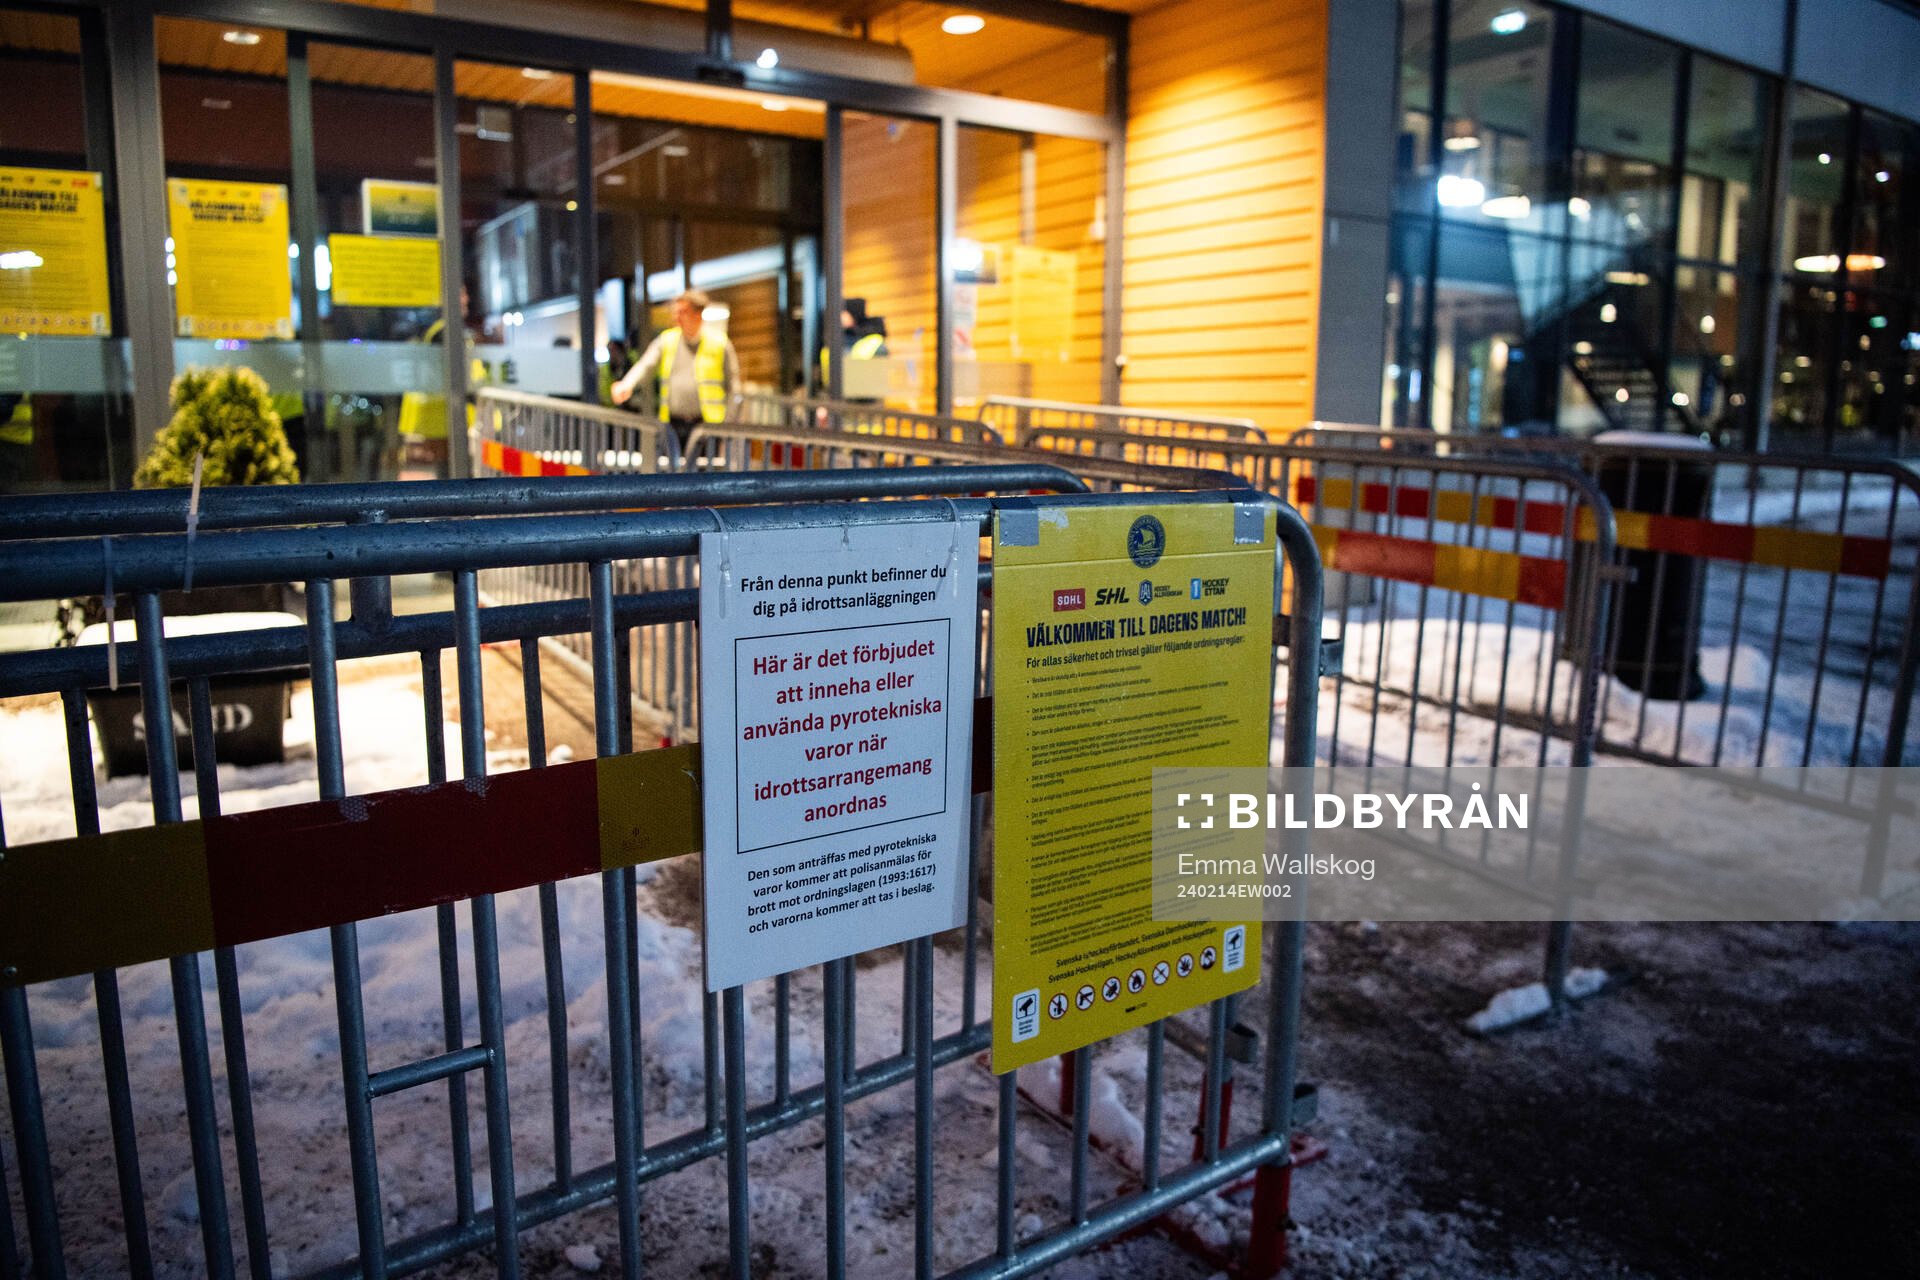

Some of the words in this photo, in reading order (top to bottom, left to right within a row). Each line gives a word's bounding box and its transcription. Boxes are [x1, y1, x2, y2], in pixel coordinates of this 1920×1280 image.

[742, 576, 773, 592] Från
[778, 575, 822, 589] denna
[828, 570, 867, 589] punkt
[872, 568, 927, 582] befinner
[931, 565, 946, 578] du
[1202, 578, 1229, 587] HOCKEY
[1205, 587, 1225, 596] ETTAN
[753, 601, 775, 617] dig
[780, 598, 796, 616] på
[802, 590, 935, 612] idrottsanläggningen
[1058, 595, 1081, 605] SDHL
[1095, 587, 1129, 605] SHL
[1027, 620, 1114, 648] VÄLKOMMEN
[1119, 617, 1145, 638] TILL
[1150, 612, 1198, 634] DAGENS
[1202, 607, 1246, 629] MATCH!
[754, 655, 787, 675] Här
[793, 653, 812, 670] är
[818, 649, 847, 667] det
[853, 640, 934, 664] förbjudet
[1027, 657, 1040, 668] För
[1042, 656, 1062, 666] allas
[1064, 651, 1098, 664] säkerhet
[1100, 649, 1114, 660] och
[1116, 646, 1139, 658] trivsel
[1141, 645, 1162, 657] gäller
[1164, 640, 1192, 653] följande
[777, 686, 803, 704] att
[809, 678, 870, 700] inneha
[876, 673, 914, 691] eller
[744, 713, 824, 740] använda
[831, 697, 941, 732] pyrotekniska
[805, 742, 853, 761] varor
[859, 734, 887, 753] när
[755, 759, 932, 801] idrottsarrangemang
[805, 795, 886, 822] anordnas
[748, 870, 769, 881] Den
[773, 864, 795, 876] som
[799, 853, 845, 870] anträffas
[849, 845, 870, 859] med
[874, 833, 936, 856] pyrotekniska
[754, 884, 783, 897] varor
[786, 873, 830, 890] kommer
[833, 869, 847, 879] att
[851, 854, 915, 878] polisanmälas
[918, 850, 931, 860] för
[748, 902, 776, 916] brott
[779, 896, 800, 909] mot
[804, 880, 875, 903] ordningslagen
[879, 864, 936, 887] (1993:1617)
[749, 920, 768, 933] och
[772, 912, 813, 927] varorna
[816, 900, 859, 917] kommer
[862, 895, 876, 906] att
[879, 892, 893, 902] tas
[896, 889, 899, 898] i
[902, 883, 934, 896] beslag.
[1056, 955, 1082, 967] Svenska
[1141, 930, 1165, 942] Svenska
[1049, 970, 1074, 983] Svenska
